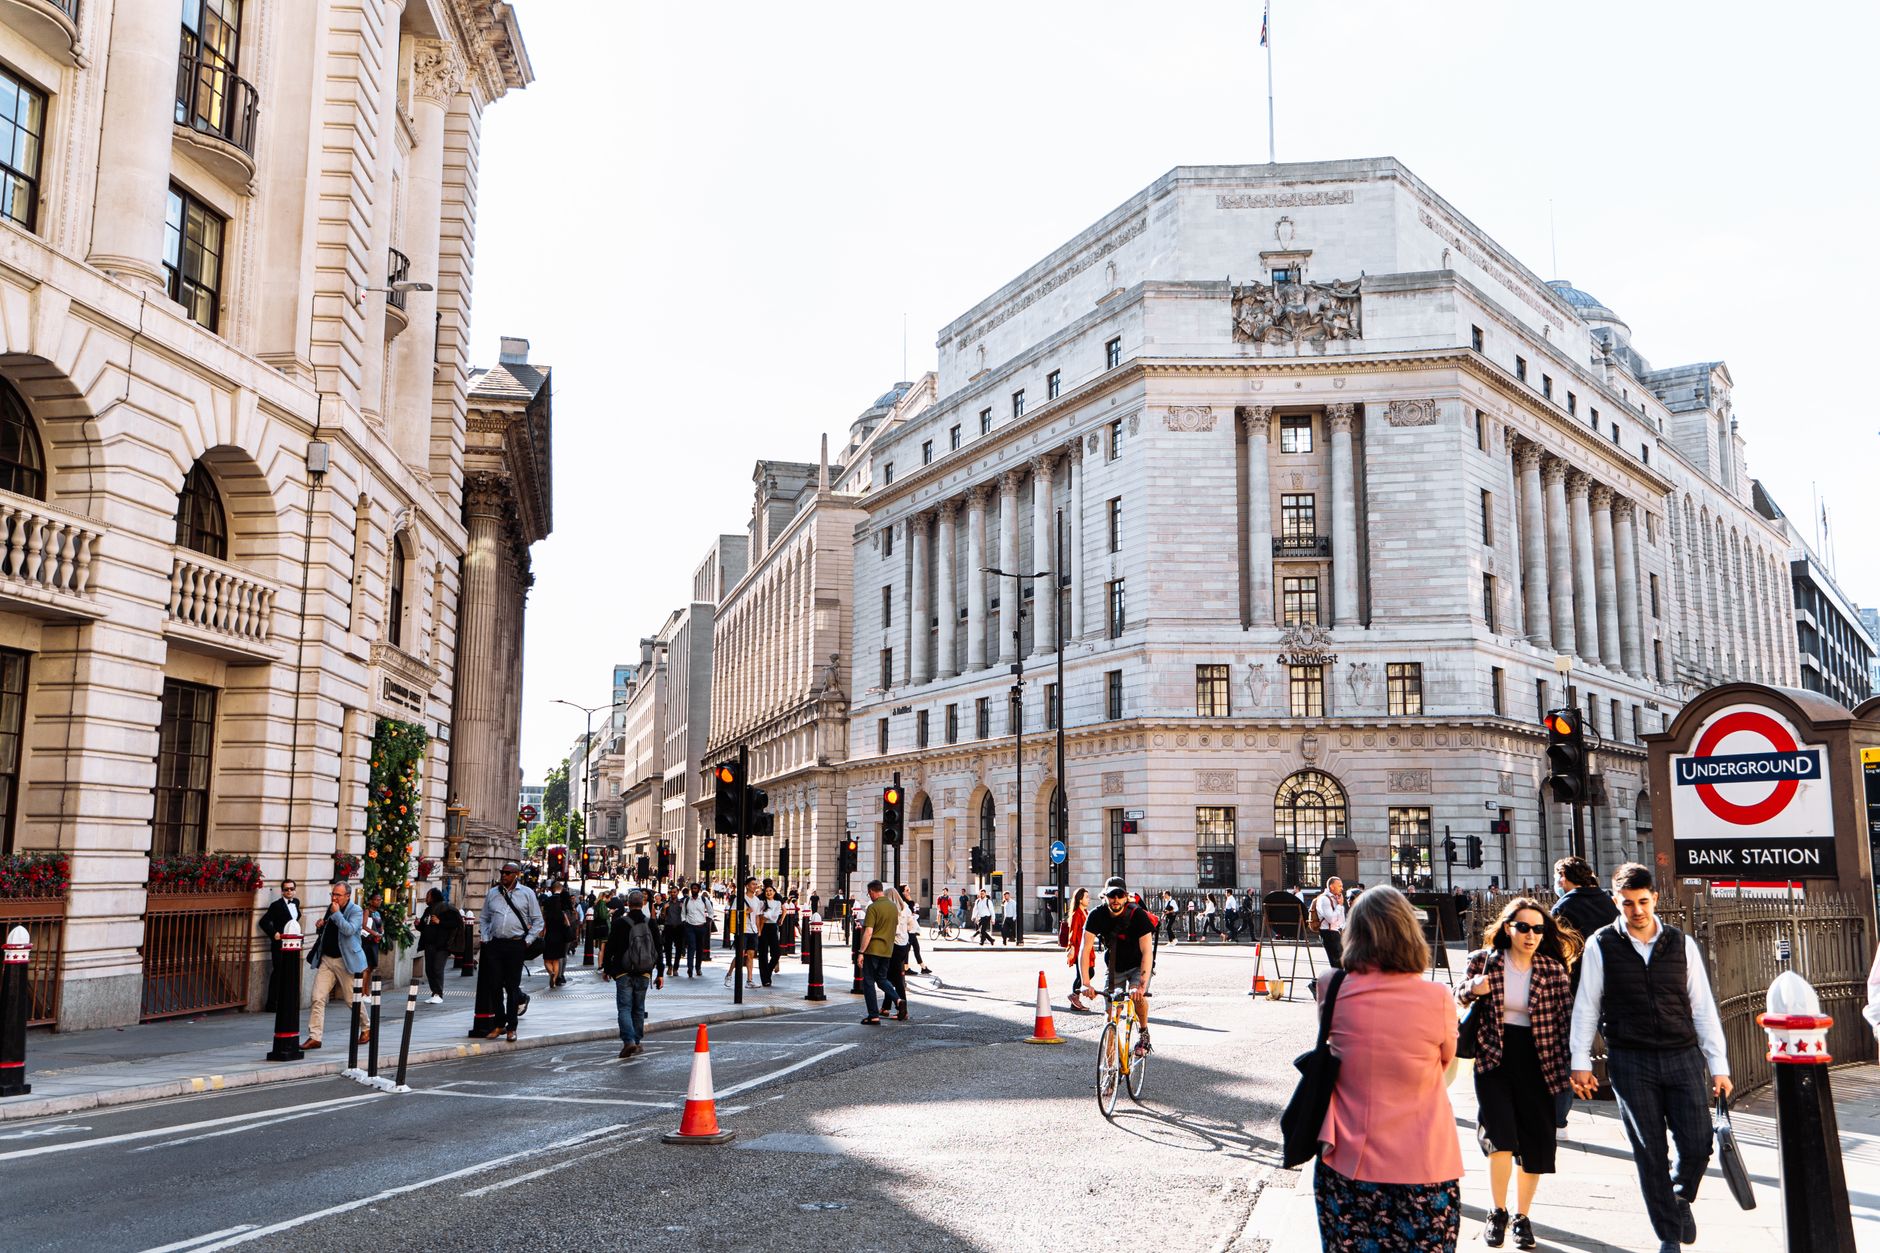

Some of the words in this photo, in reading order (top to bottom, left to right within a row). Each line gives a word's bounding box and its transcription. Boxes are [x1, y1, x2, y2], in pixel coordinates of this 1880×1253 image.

[1290, 653, 1339, 664] NatWest
[1682, 756, 1813, 780] UNDERGROUND
[1688, 849, 1735, 865] BANK
[1741, 848, 1820, 864] STATION
